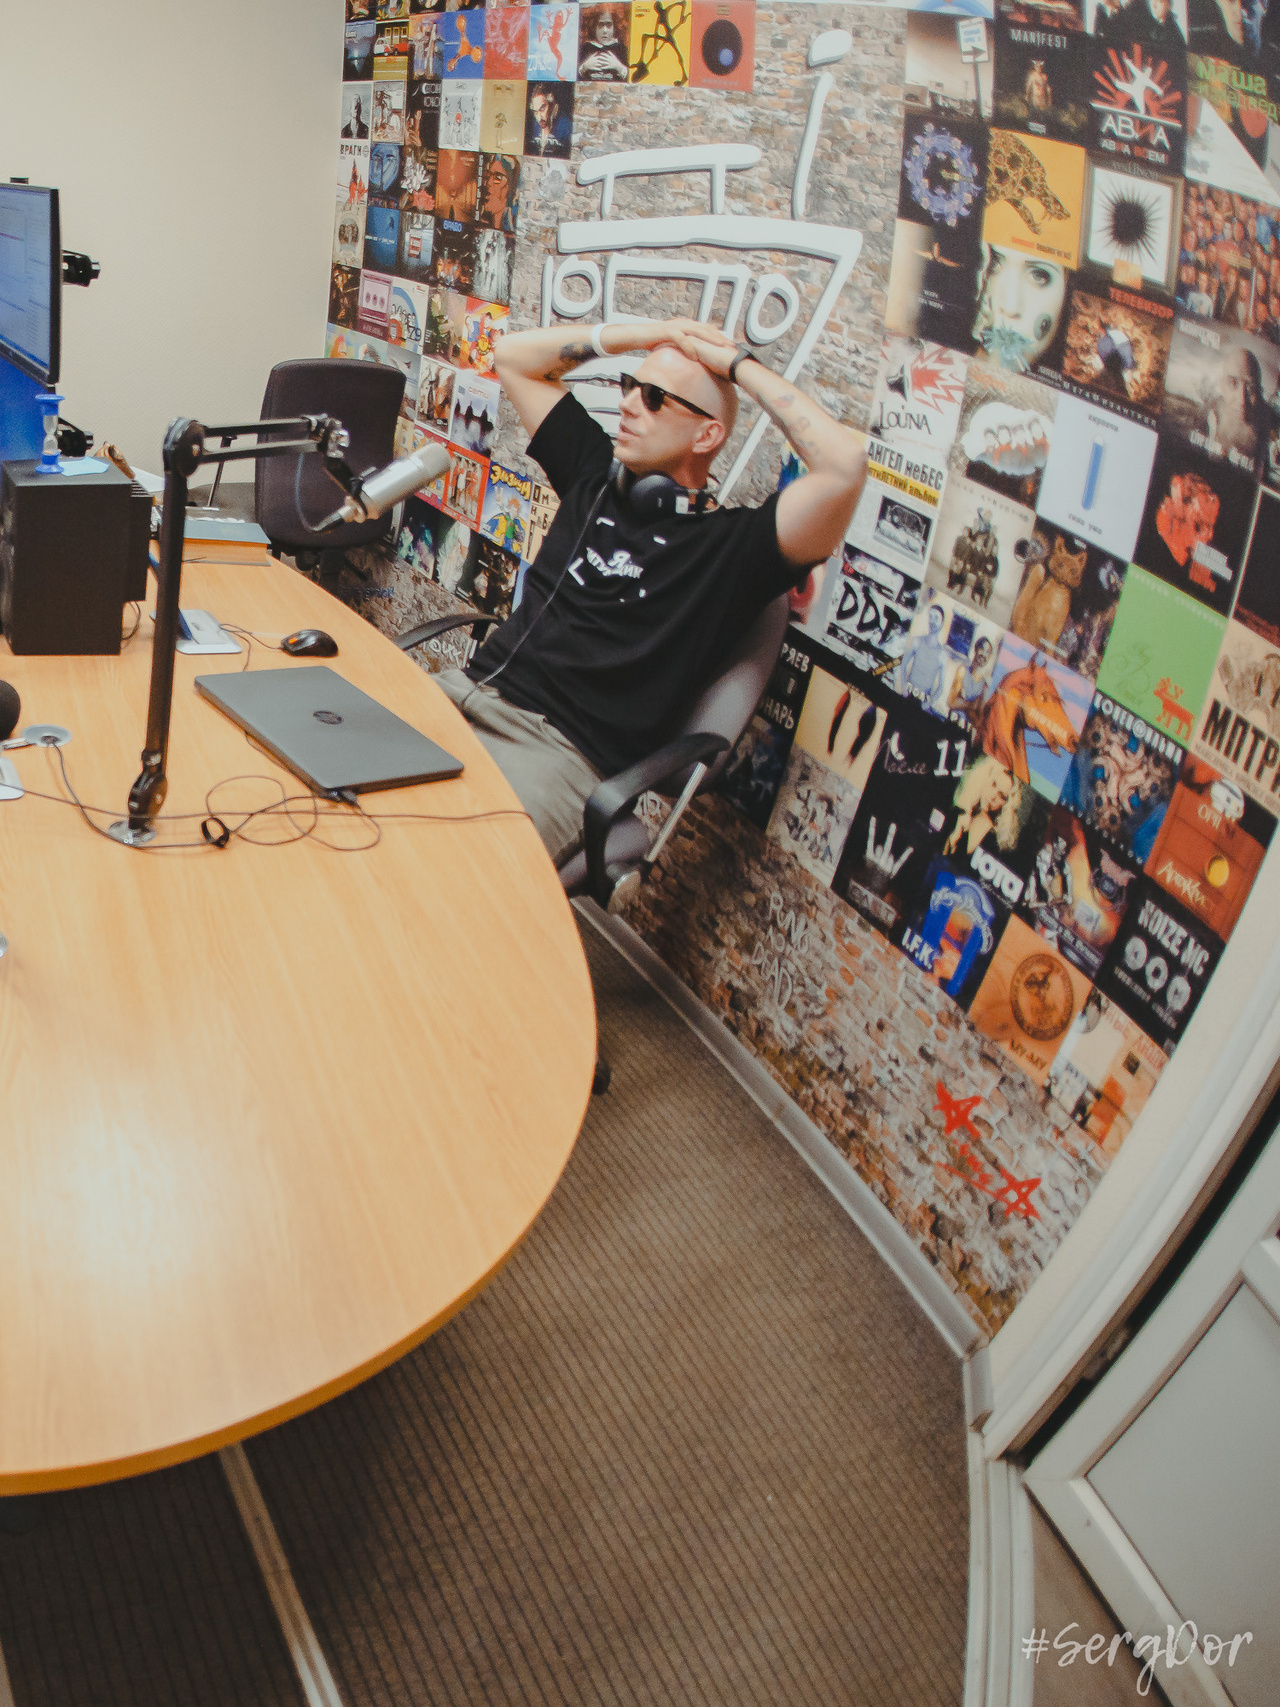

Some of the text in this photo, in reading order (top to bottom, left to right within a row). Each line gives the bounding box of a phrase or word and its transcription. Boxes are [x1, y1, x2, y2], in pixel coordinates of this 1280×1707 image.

[1011, 29, 1067, 48] MANIFEST
[1137, 899, 1188, 957] NOIZE
[1180, 936, 1210, 977] MC
